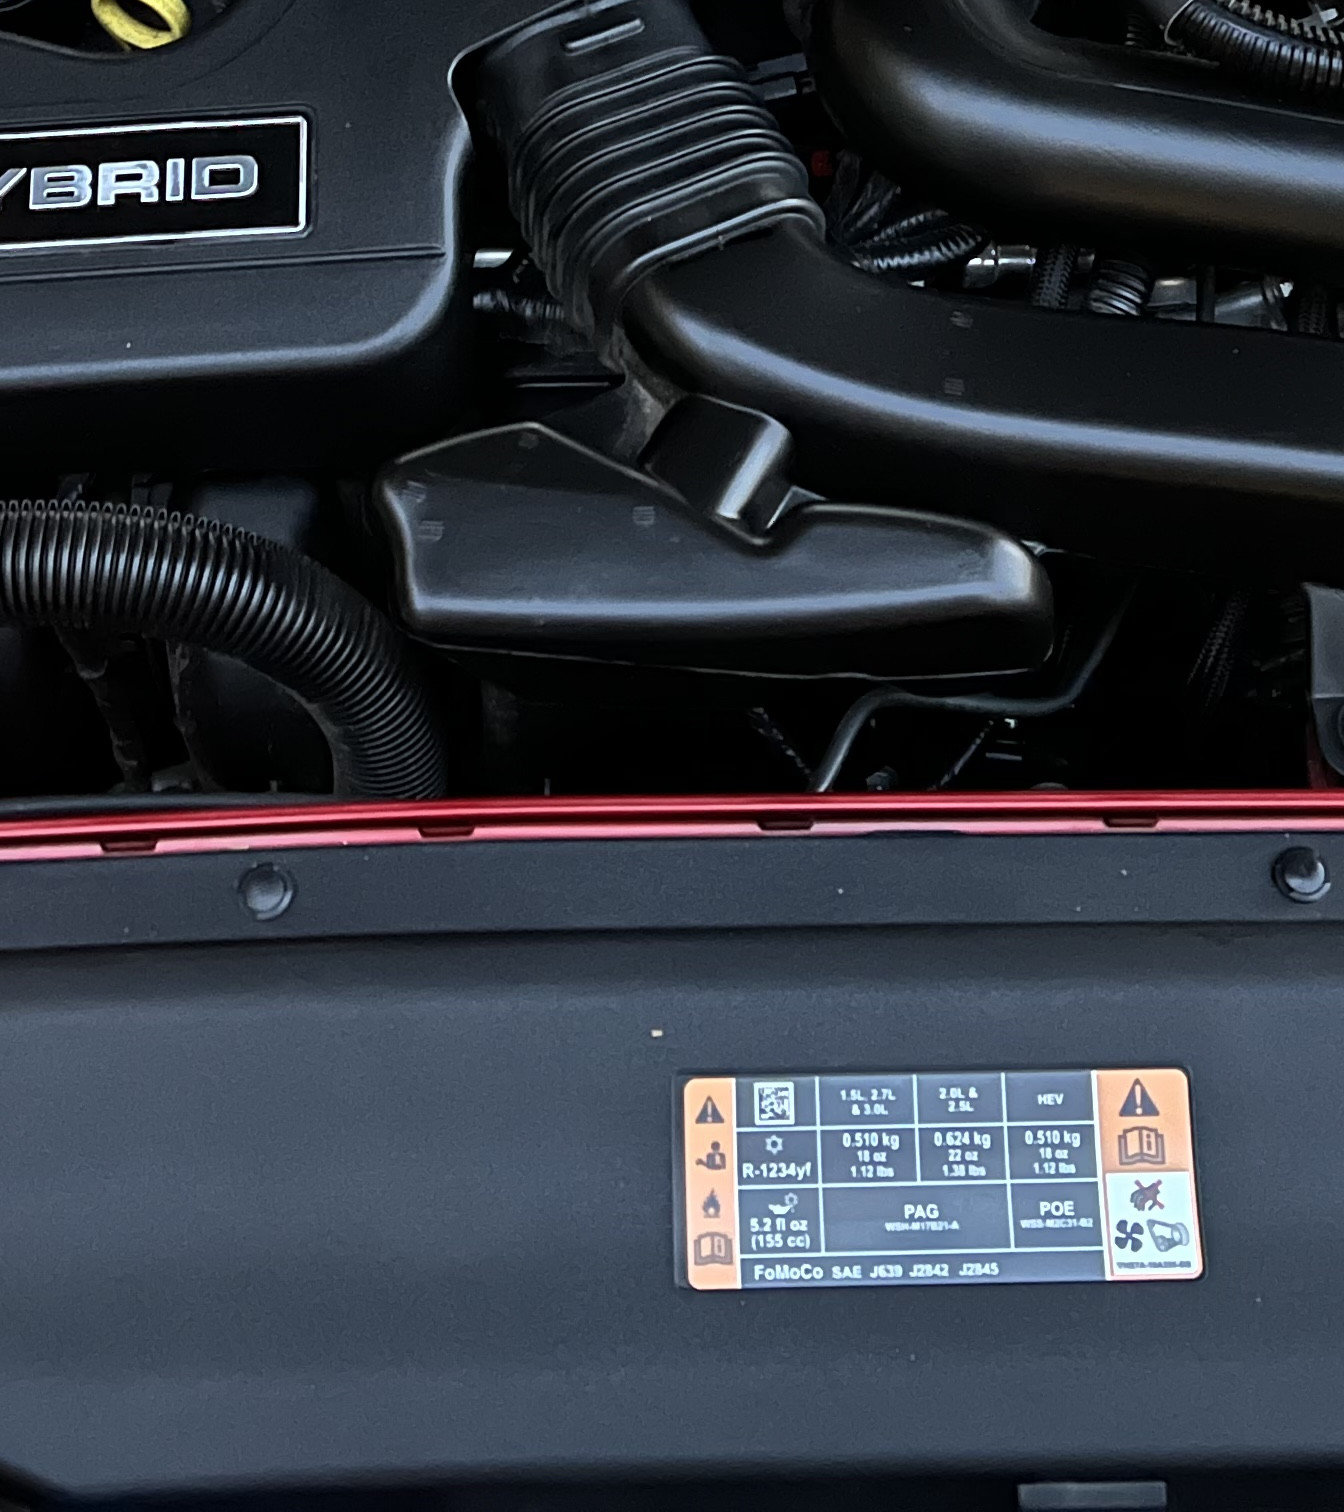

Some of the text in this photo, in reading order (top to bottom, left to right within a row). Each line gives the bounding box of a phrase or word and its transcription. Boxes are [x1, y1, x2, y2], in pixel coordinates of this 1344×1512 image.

[1037, 1093, 1064, 1106] HEV
[842, 1132, 900, 1150] 0.510 kg
[934, 1130, 991, 1149] 0.624 kg
[1024, 1130, 1080, 1148] 0.510 kg
[857, 1150, 887, 1162] 18 oz
[948, 1149, 978, 1162] 22 oz
[1039, 1147, 1068, 1159] 18 oz
[742, 1161, 812, 1181] R-1234yf
[850, 1165, 874, 1178] 1.12
[1033, 1162, 1056, 1174] 1.12
[904, 1204, 940, 1220] PAG
[1040, 1200, 1075, 1216] POE
[750, 1218, 808, 1232] 5.2 fl oz
[751, 1233, 810, 1251] (155 cc)
[754, 1262, 1000, 1282] FoMoCo SAE J639 J2842 J2845
